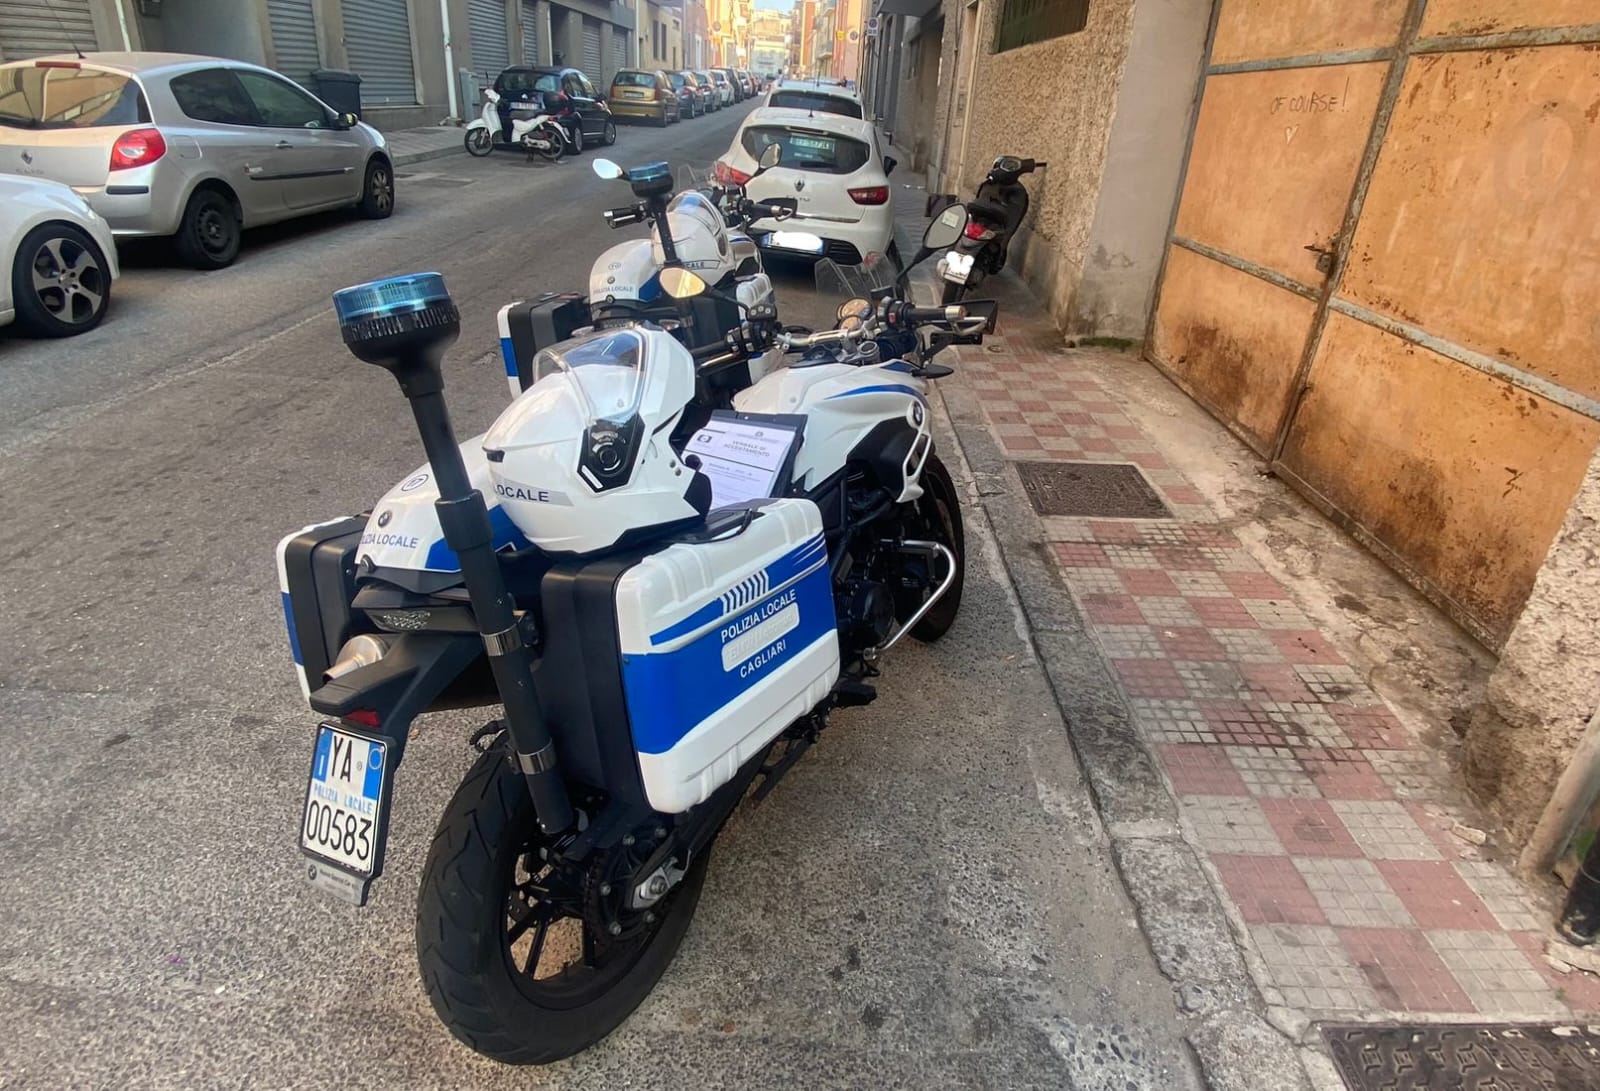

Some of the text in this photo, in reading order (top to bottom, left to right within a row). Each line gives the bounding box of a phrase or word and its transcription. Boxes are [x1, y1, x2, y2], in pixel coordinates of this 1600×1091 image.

[1270, 96, 1288, 115] OF
[494, 484, 550, 503] OCALE
[377, 534, 419, 549] LOCALE
[721, 611, 761, 643] POLIZIA
[761, 588, 797, 619] LOCALE
[740, 639, 787, 678] CAGLIARI
[331, 735, 353, 782] YA
[314, 783, 373, 815] POLIZIA LOCALE
[306, 800, 372, 861] 00583
